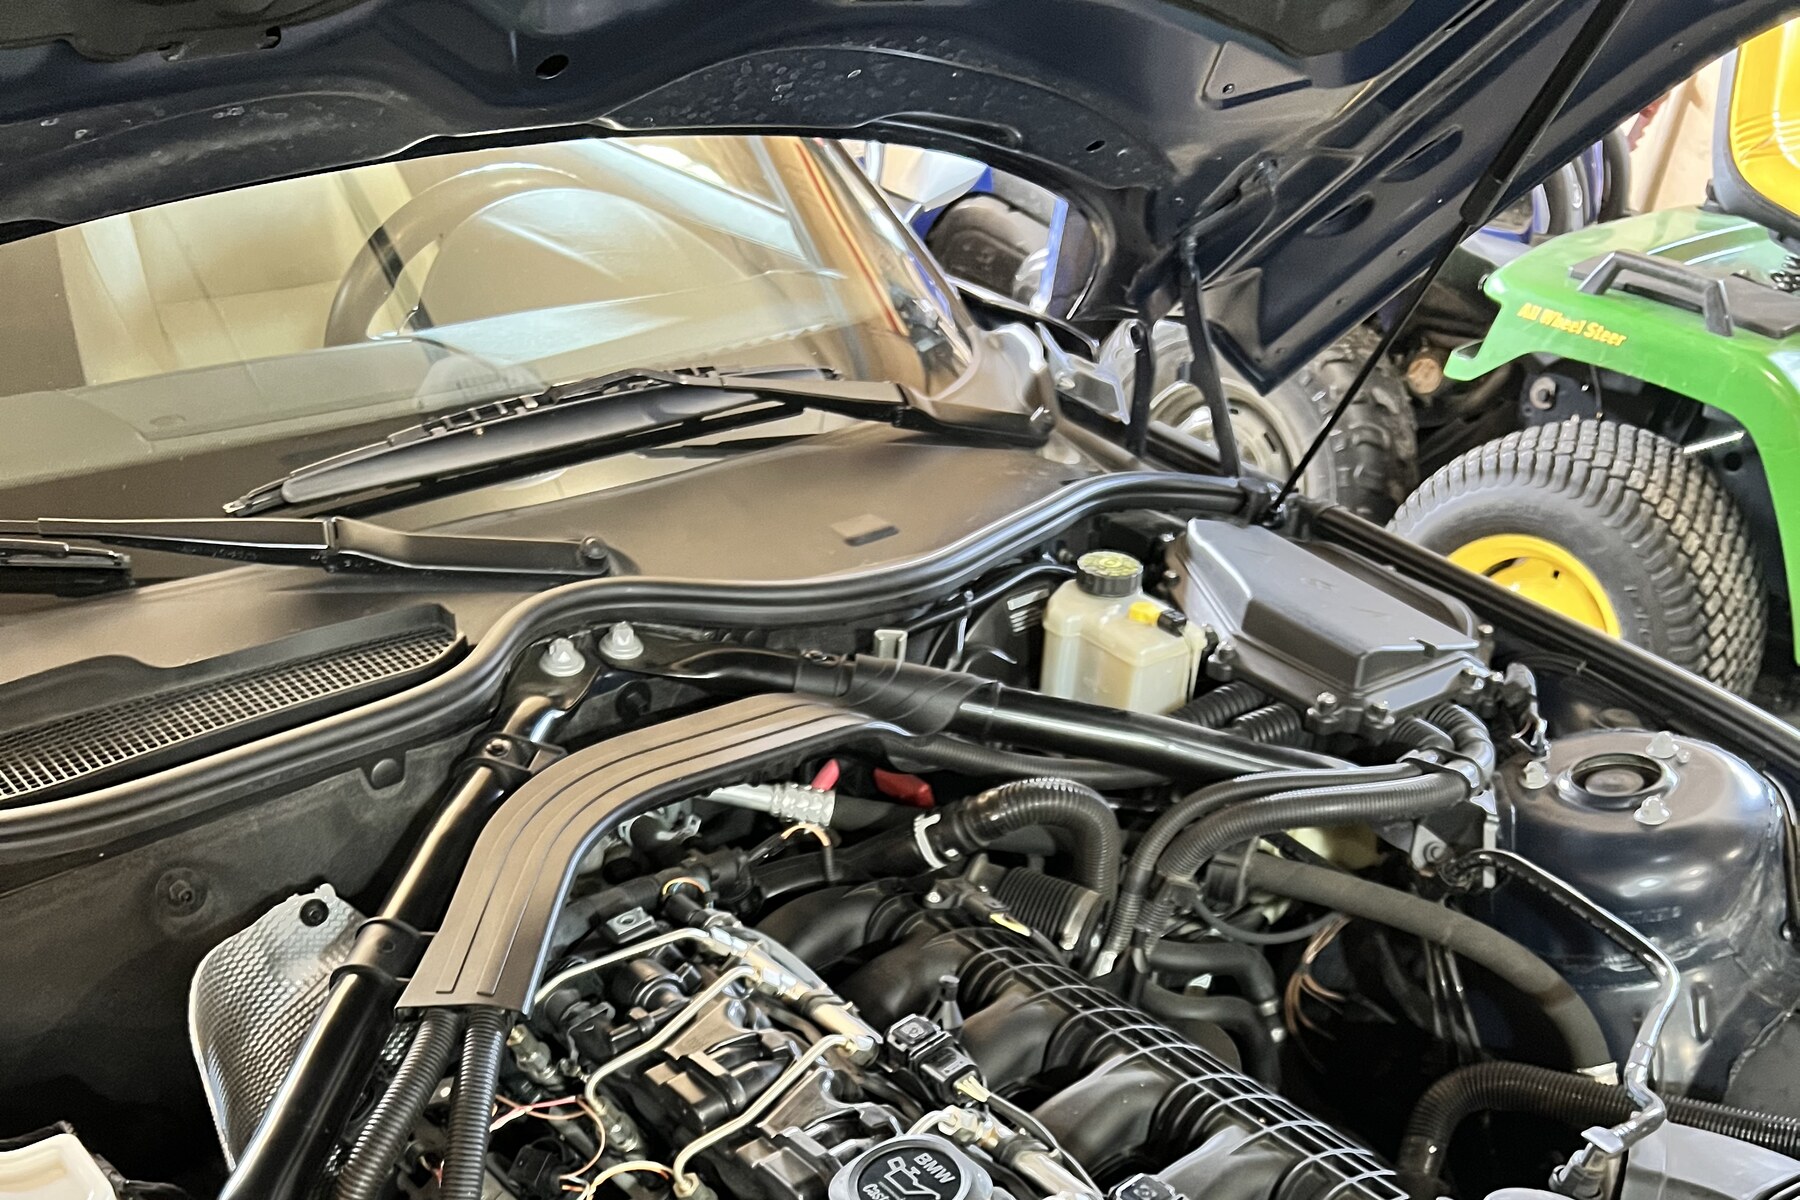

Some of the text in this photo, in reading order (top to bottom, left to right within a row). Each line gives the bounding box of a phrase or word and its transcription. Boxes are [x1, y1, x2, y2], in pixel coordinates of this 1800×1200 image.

[1540, 308, 1587, 335] Wheel
[1583, 321, 1628, 347] Steer
[914, 1152, 956, 1184] BMW
